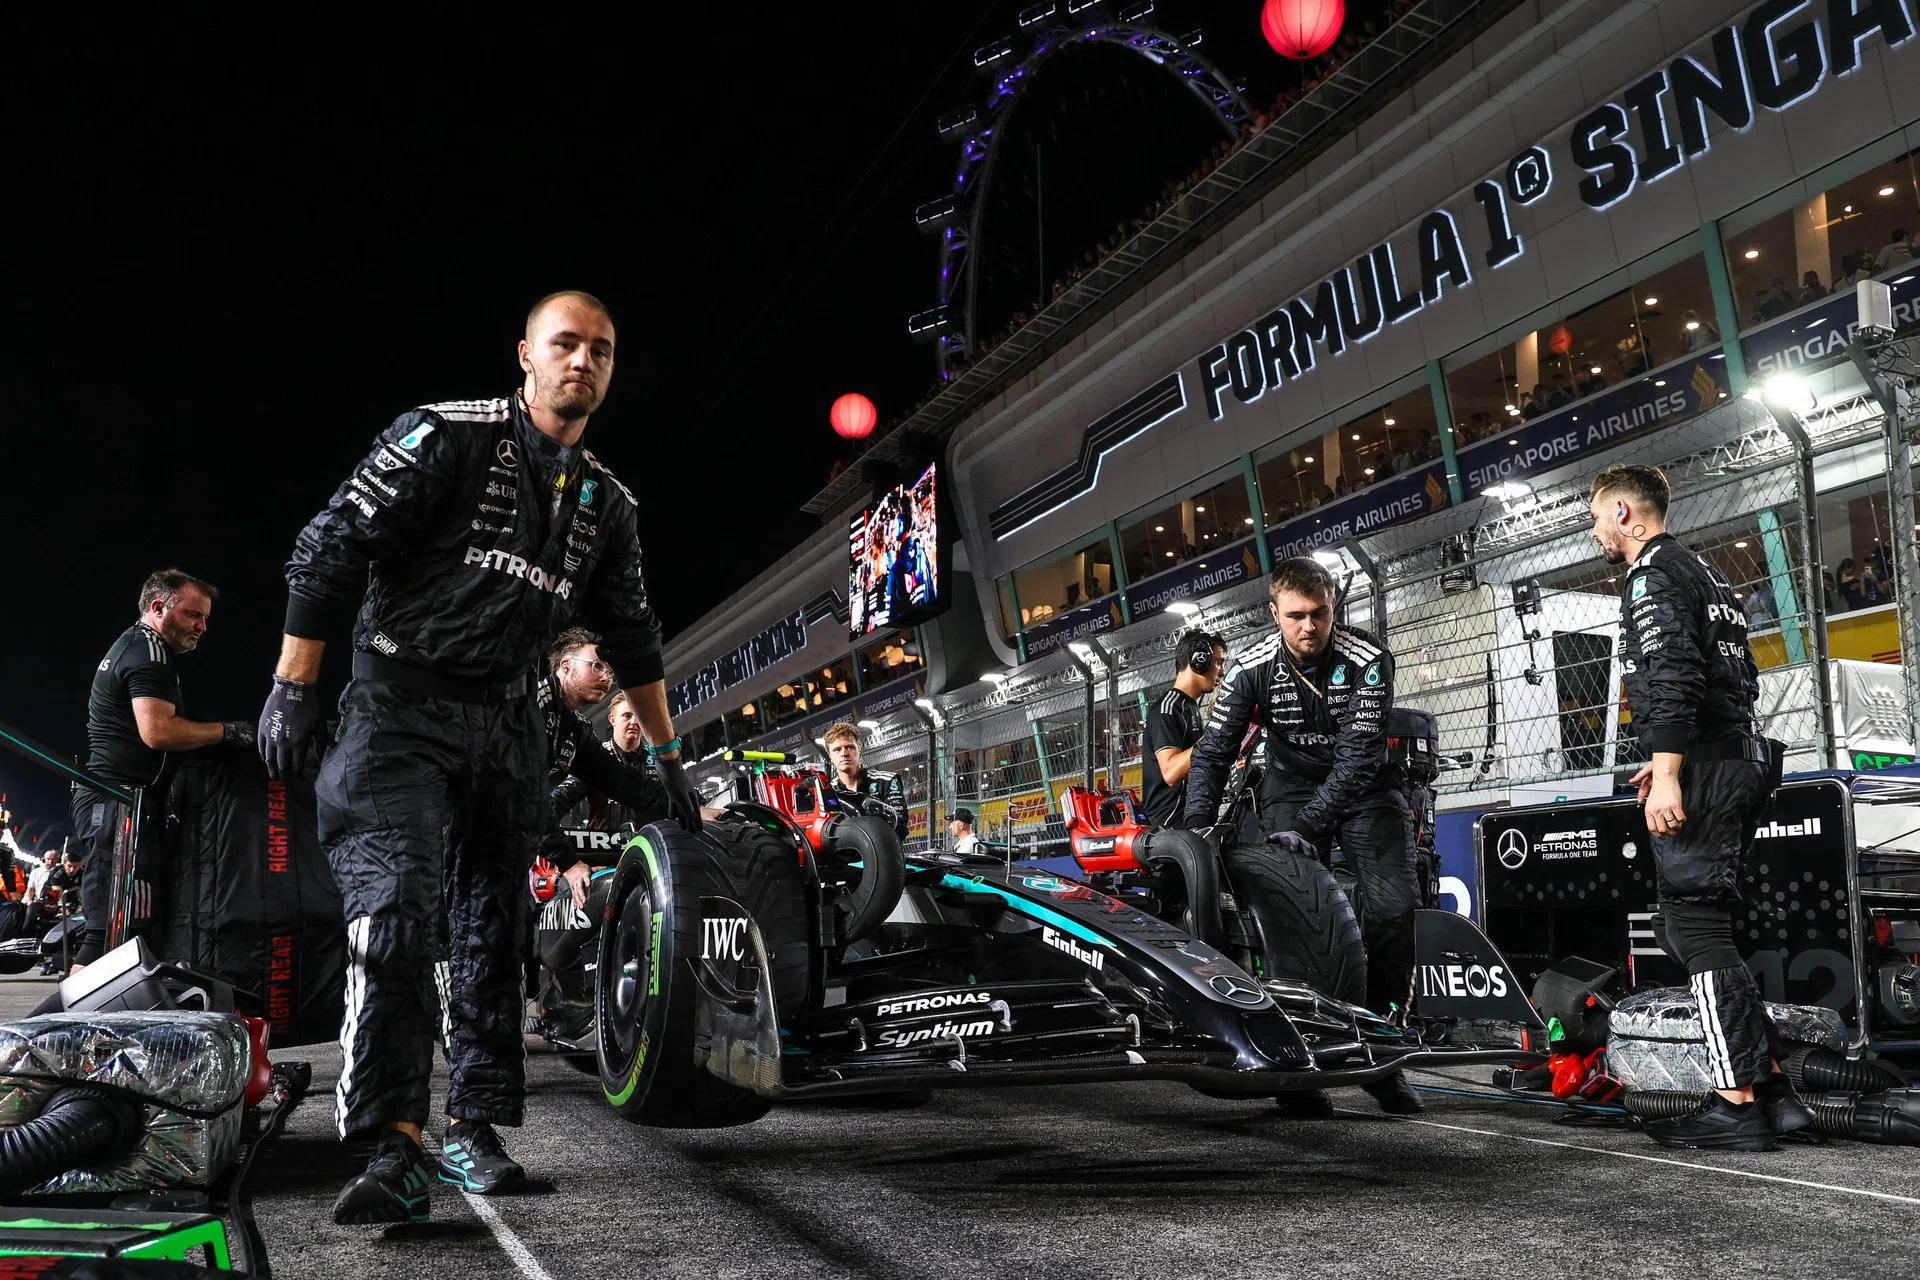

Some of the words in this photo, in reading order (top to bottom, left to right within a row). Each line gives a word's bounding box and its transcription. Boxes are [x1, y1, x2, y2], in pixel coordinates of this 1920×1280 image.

[1199, 208, 1472, 421] FORMULA
[1571, 0, 1918, 211] SINGA
[1468, 431, 1580, 490] SINGAPORE
[1586, 389, 1687, 446] AIRLINES
[377, 452, 397, 469] SAP
[361, 468, 398, 497] Einhell
[501, 484, 517, 499] UB
[1274, 520, 1351, 562] SINGAPORE
[1355, 492, 1423, 532] AIRLINES
[463, 546, 573, 600] PETRONAS
[1133, 582, 1190, 616] SINGAPORE
[1193, 562, 1242, 593] AIRLINES
[374, 634, 397, 654] OMP
[1028, 629, 1072, 655] SINGAPORE
[1073, 613, 1110, 641] AIRLINES
[864, 697, 893, 716] SINGAPORE
[1281, 692, 1298, 701] UBS
[1328, 693, 1352, 705] INEO
[1360, 700, 1380, 708] IWC
[270, 710, 283, 741] HyFlex
[268, 780, 288, 821] REAR
[1558, 829, 1597, 839] AMG
[1755, 817, 1822, 839] nhell
[268, 825, 288, 873] RIGHT
[1533, 840, 1597, 852] PETRONAS
[1542, 852, 1567, 860] FORMULA
[1569, 851, 1581, 859] ONE
[1582, 850, 1598, 858] TEAM
[539, 899, 592, 931] TRONAS
[701, 917, 748, 961] IWC
[1043, 925, 1104, 971] Einhell
[271, 936, 292, 981] REAR
[1421, 964, 1508, 998] INEOS
[1745, 948, 1855, 1012] 12
[877, 992, 991, 1017] PETRONAS
[875, 1020, 995, 1048] Syntium
